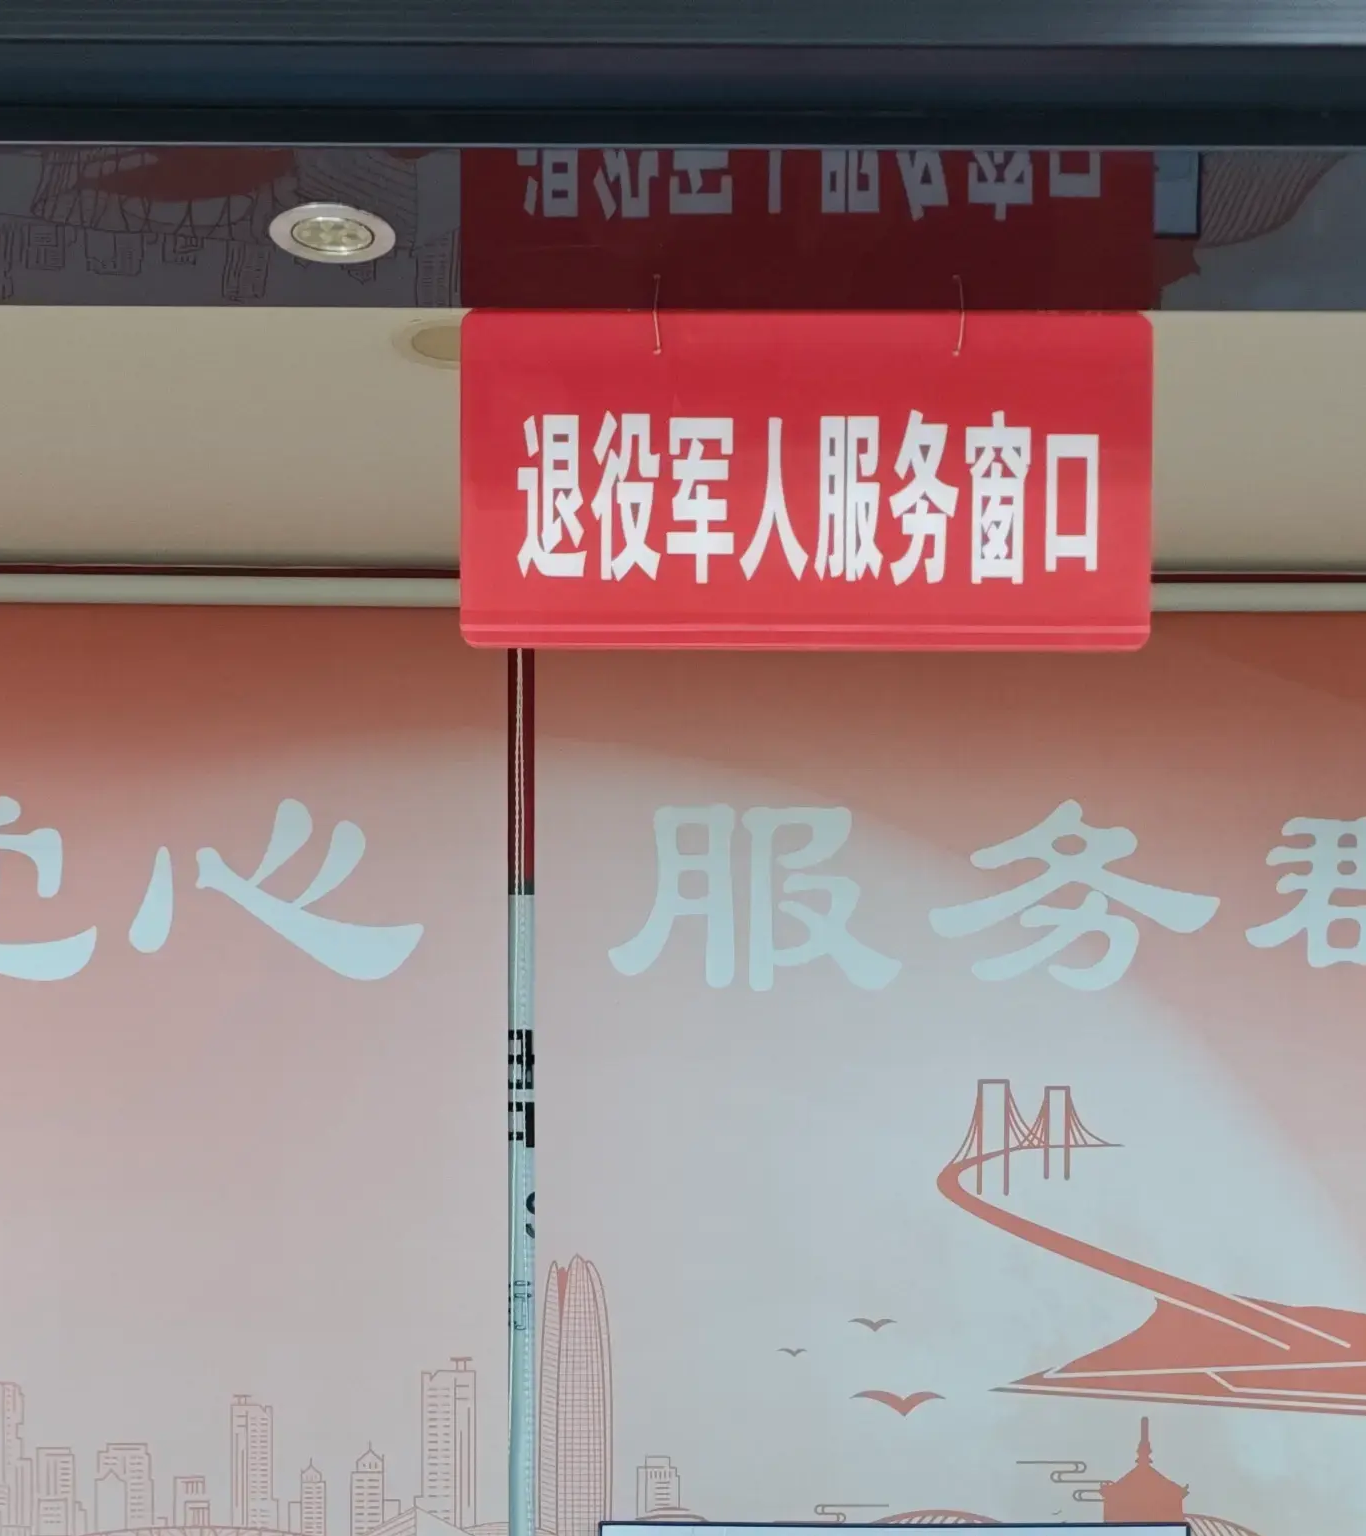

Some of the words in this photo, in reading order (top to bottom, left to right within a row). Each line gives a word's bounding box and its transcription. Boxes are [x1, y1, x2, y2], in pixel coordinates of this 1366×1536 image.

[516, 410, 1100, 585] 退役军人服务窗口
